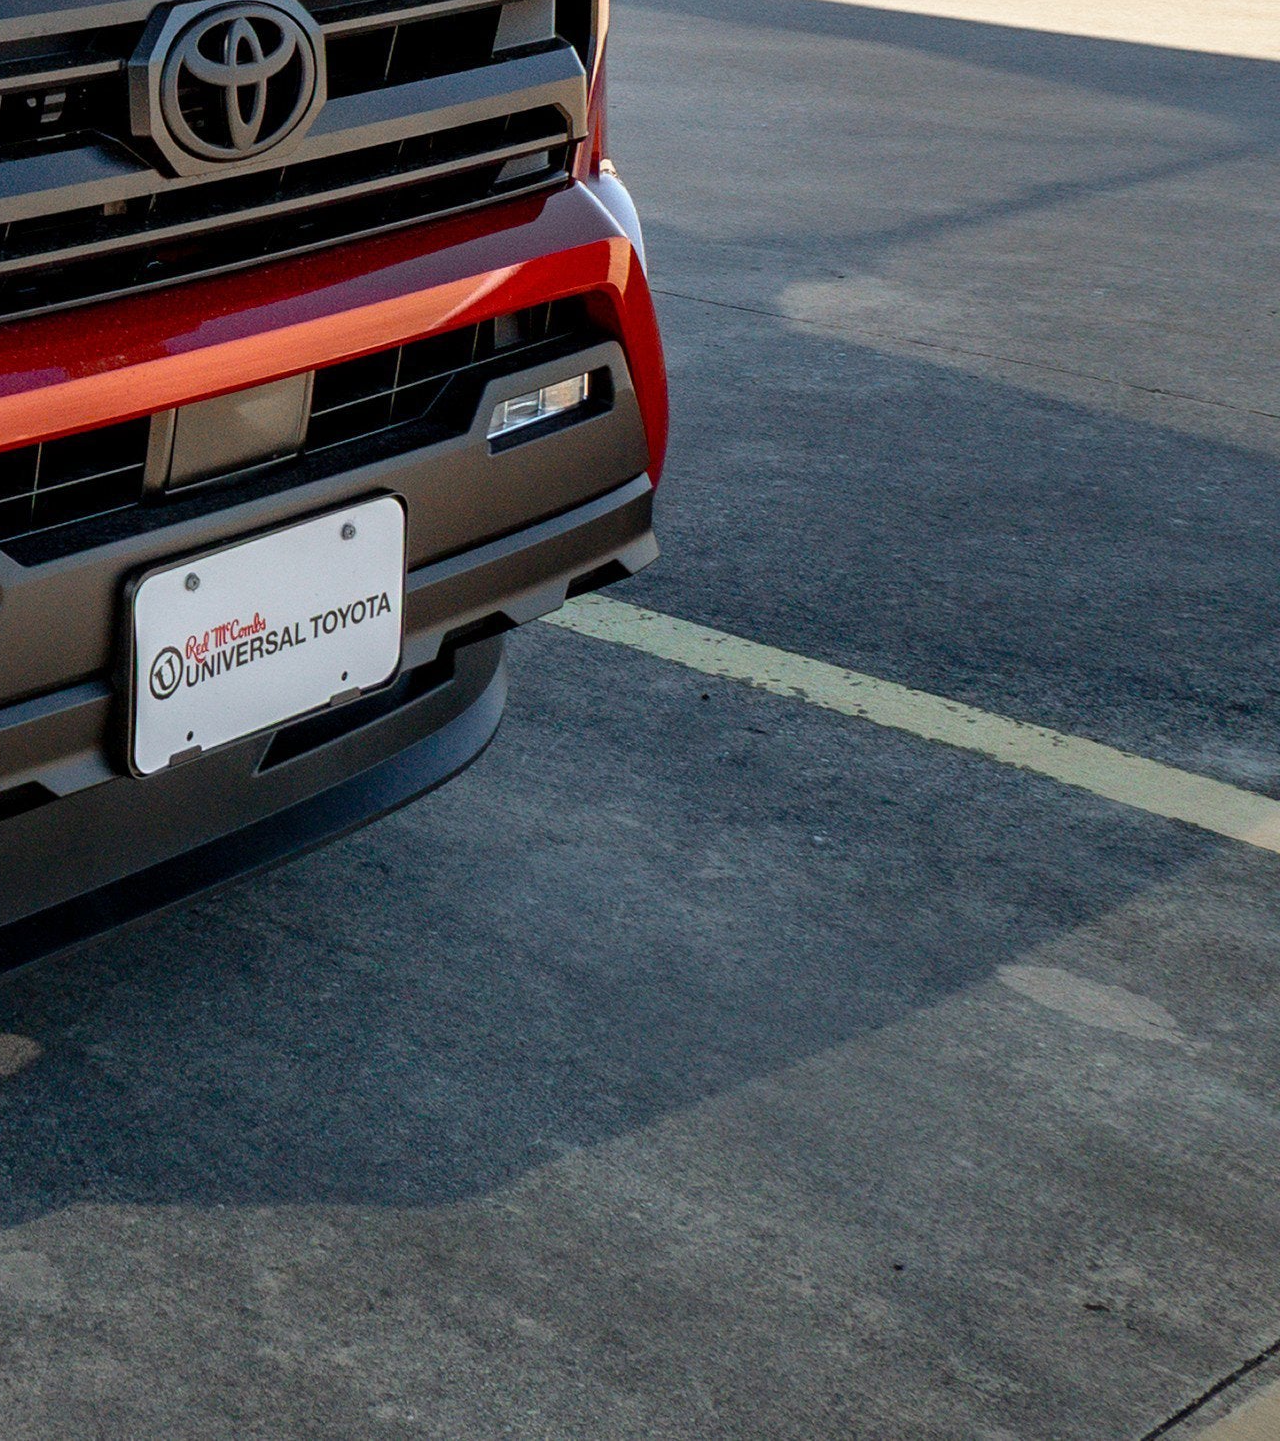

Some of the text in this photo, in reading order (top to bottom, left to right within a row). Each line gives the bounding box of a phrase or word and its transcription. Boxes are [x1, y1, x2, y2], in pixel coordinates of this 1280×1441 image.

[185, 630, 211, 664] Red
[186, 592, 392, 688] UNIVERSAL TOYOTA
